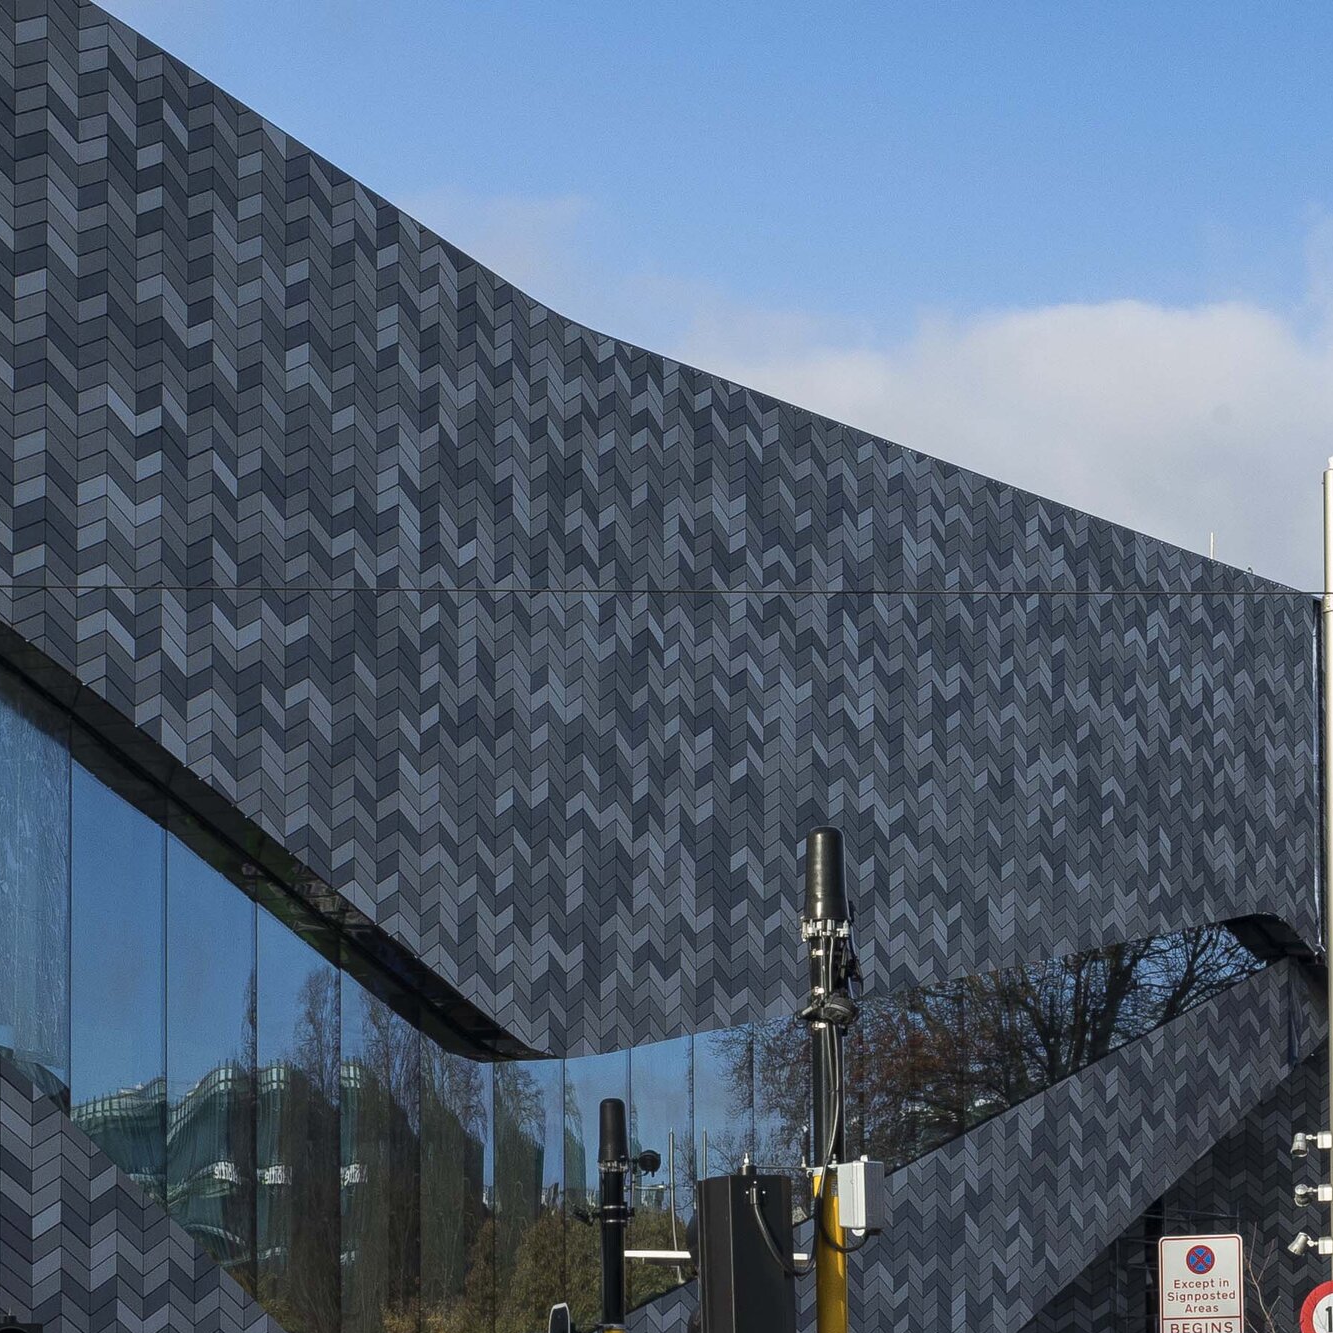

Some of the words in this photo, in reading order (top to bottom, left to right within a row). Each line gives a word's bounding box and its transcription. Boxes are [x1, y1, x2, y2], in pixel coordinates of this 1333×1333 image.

[1174, 1279, 1215, 1290] Except
[1219, 1278, 1229, 1287] in
[1167, 1290, 1236, 1302] Signposted
[1185, 1304, 1219, 1313] Areas
